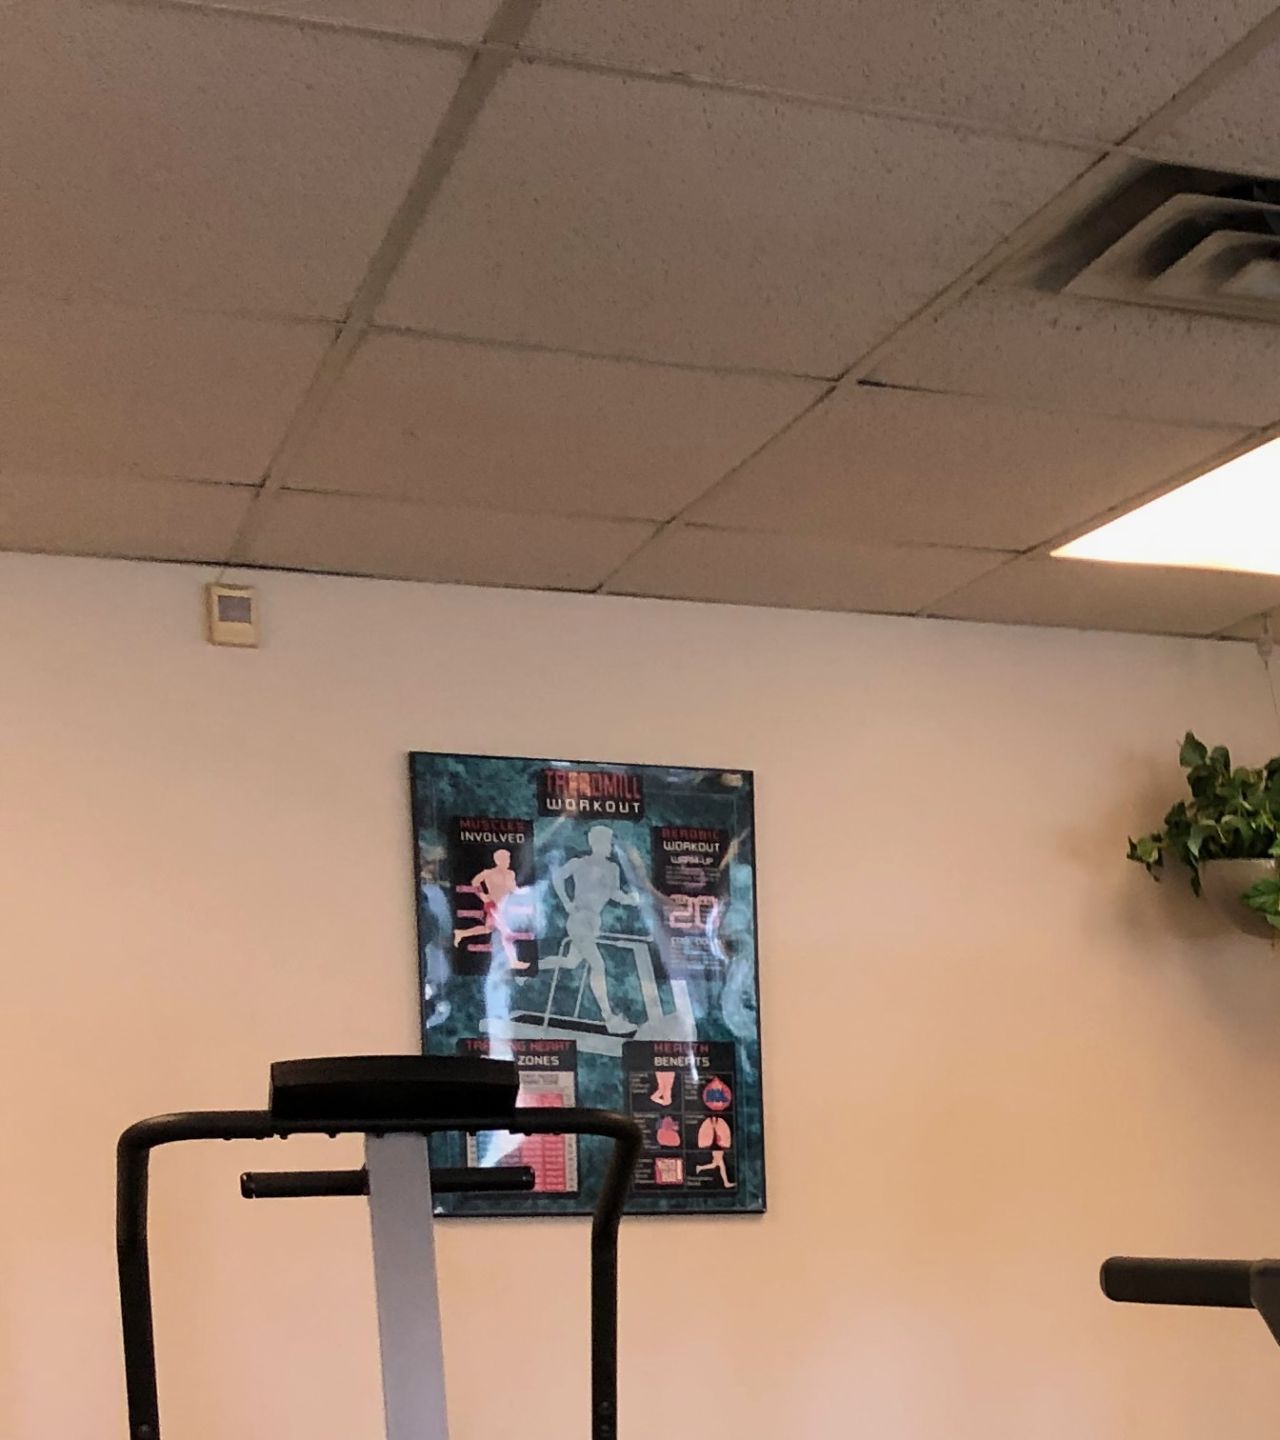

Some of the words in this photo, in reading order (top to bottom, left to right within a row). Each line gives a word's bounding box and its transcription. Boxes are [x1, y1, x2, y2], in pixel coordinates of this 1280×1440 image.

[546, 798, 641, 814] WORKOUT
[460, 831, 525, 844] INVOLVED
[663, 840, 720, 852] WORKOUT
[517, 1055, 560, 1066] ZONES
[653, 1056, 711, 1067] BENEFTS
